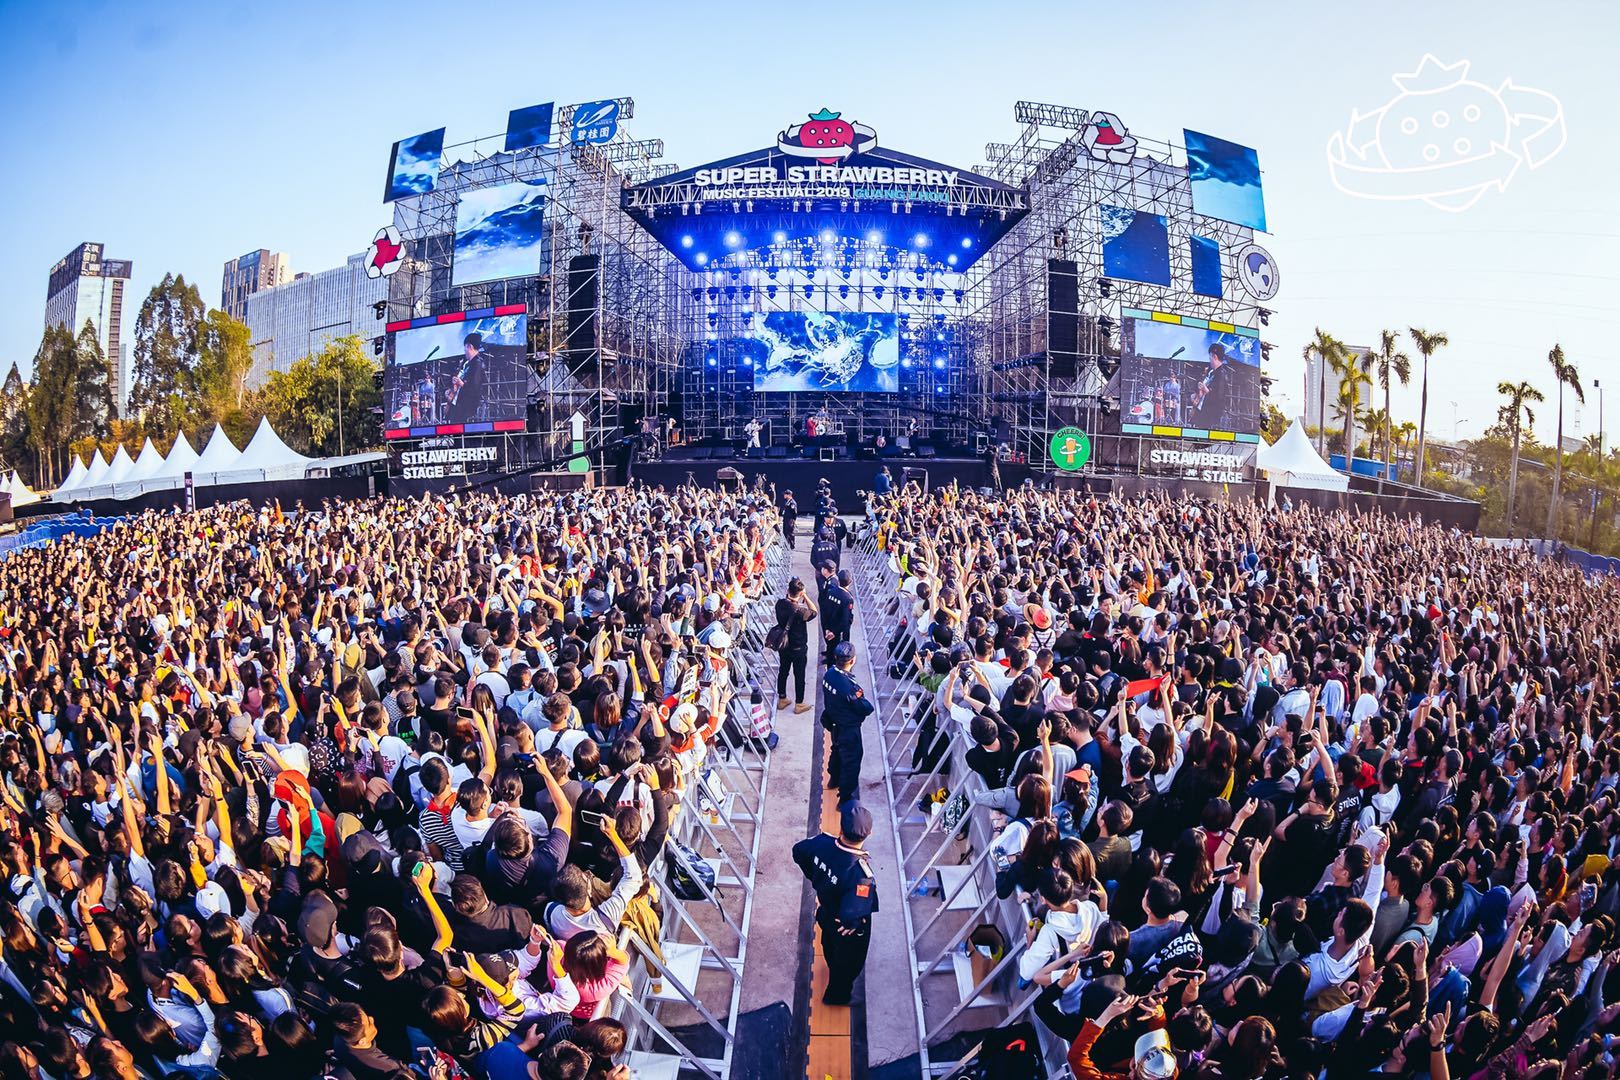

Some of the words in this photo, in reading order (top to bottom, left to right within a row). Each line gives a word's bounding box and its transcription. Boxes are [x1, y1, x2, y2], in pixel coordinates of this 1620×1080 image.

[695, 166, 778, 187] SUPER
[788, 164, 959, 187] STRAWBERRY
[703, 187, 747, 200] MUSIC
[749, 186, 814, 199] FESTIVAL
[816, 186, 851, 198] 2019
[401, 447, 497, 465] STRAWBERRY
[1150, 449, 1244, 468] STRAWBERRY
[403, 465, 445, 480] STAGE
[1202, 469, 1243, 483] STAGE
